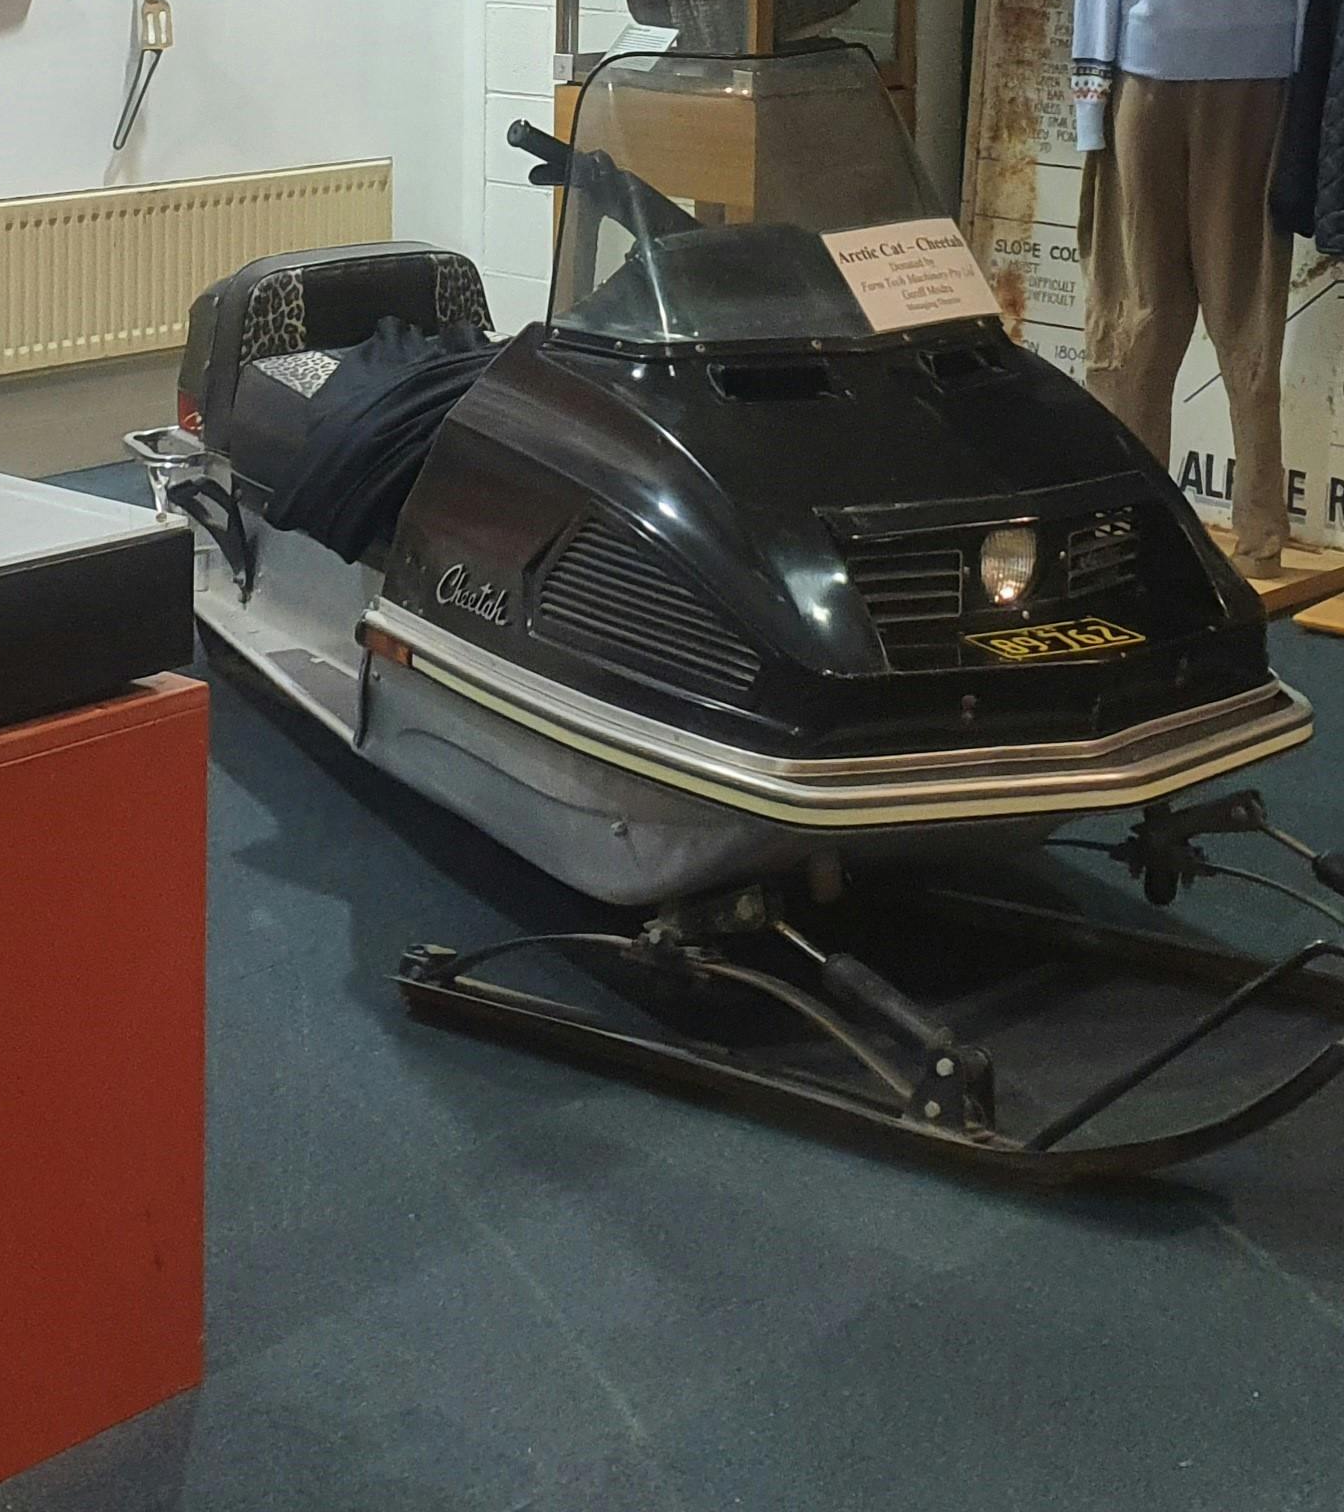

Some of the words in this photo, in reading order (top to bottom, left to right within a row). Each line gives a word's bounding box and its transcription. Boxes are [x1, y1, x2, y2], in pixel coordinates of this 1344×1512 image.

[838, 246, 880, 264] Arctic
[879, 241, 905, 257] Cat
[916, 235, 964, 251] Cheetah
[994, 239, 1041, 259] SLOPE
[436, 563, 508, 625] Cheetah
